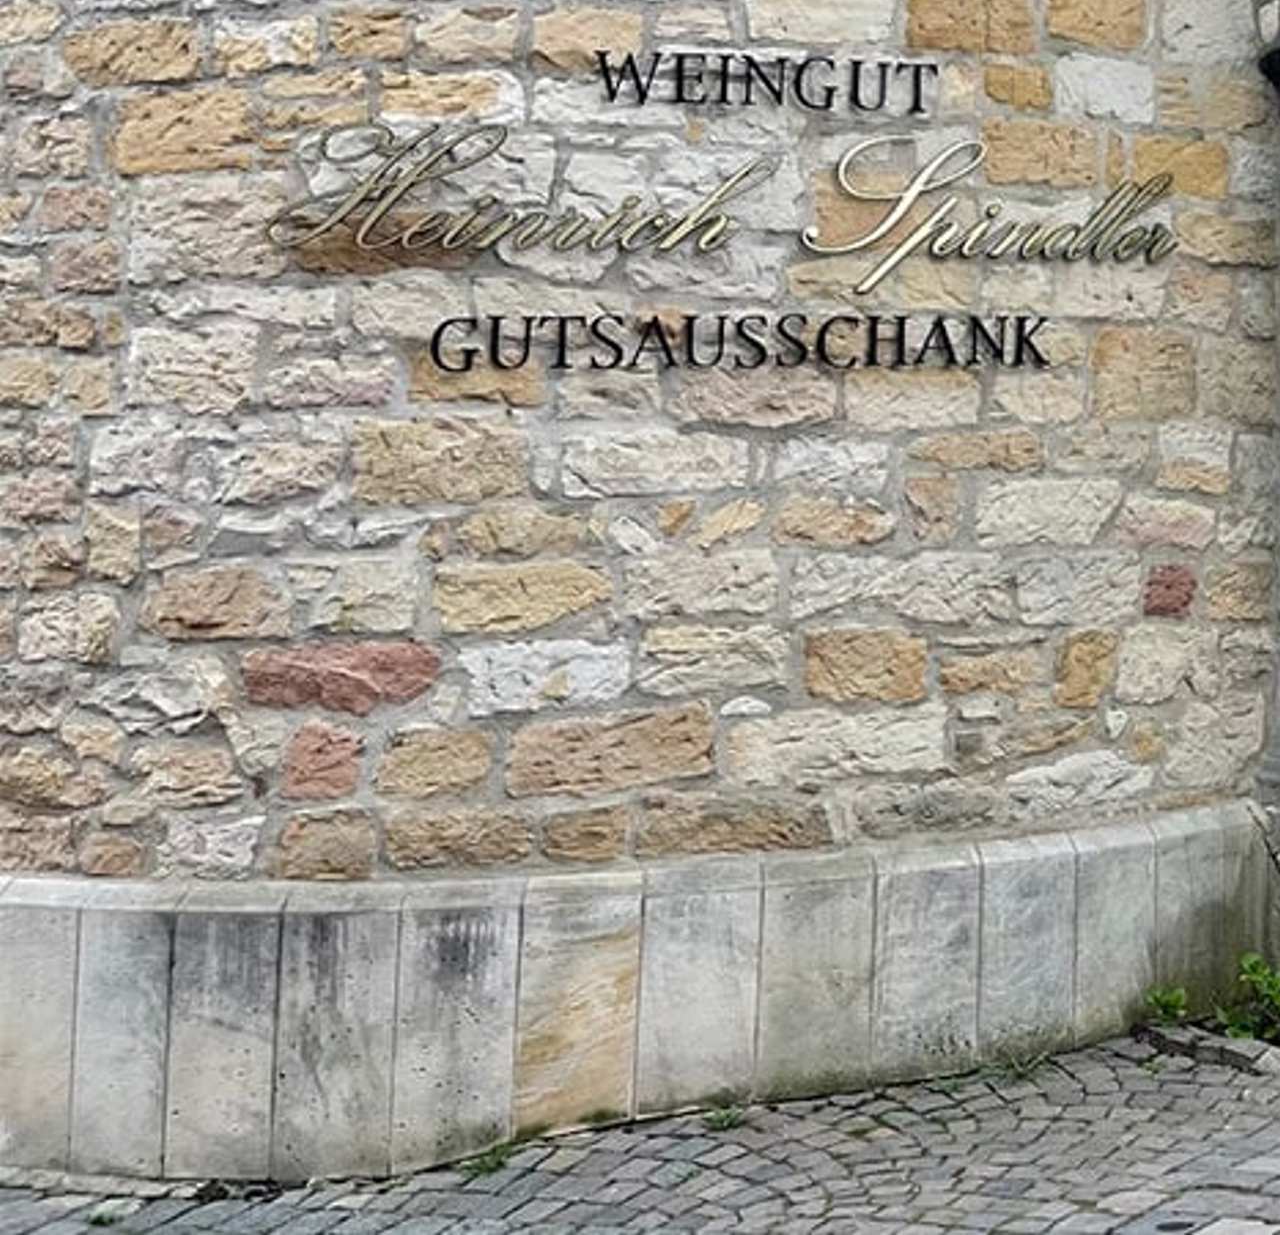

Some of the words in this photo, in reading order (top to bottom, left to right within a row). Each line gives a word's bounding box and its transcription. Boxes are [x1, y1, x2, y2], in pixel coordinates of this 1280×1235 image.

[594, 50, 940, 115] WEINGUT
[267, 123, 784, 253] Heinrich
[801, 135, 1179, 295] Spindler
[430, 313, 1052, 372] GUTSAUSSCHANK
